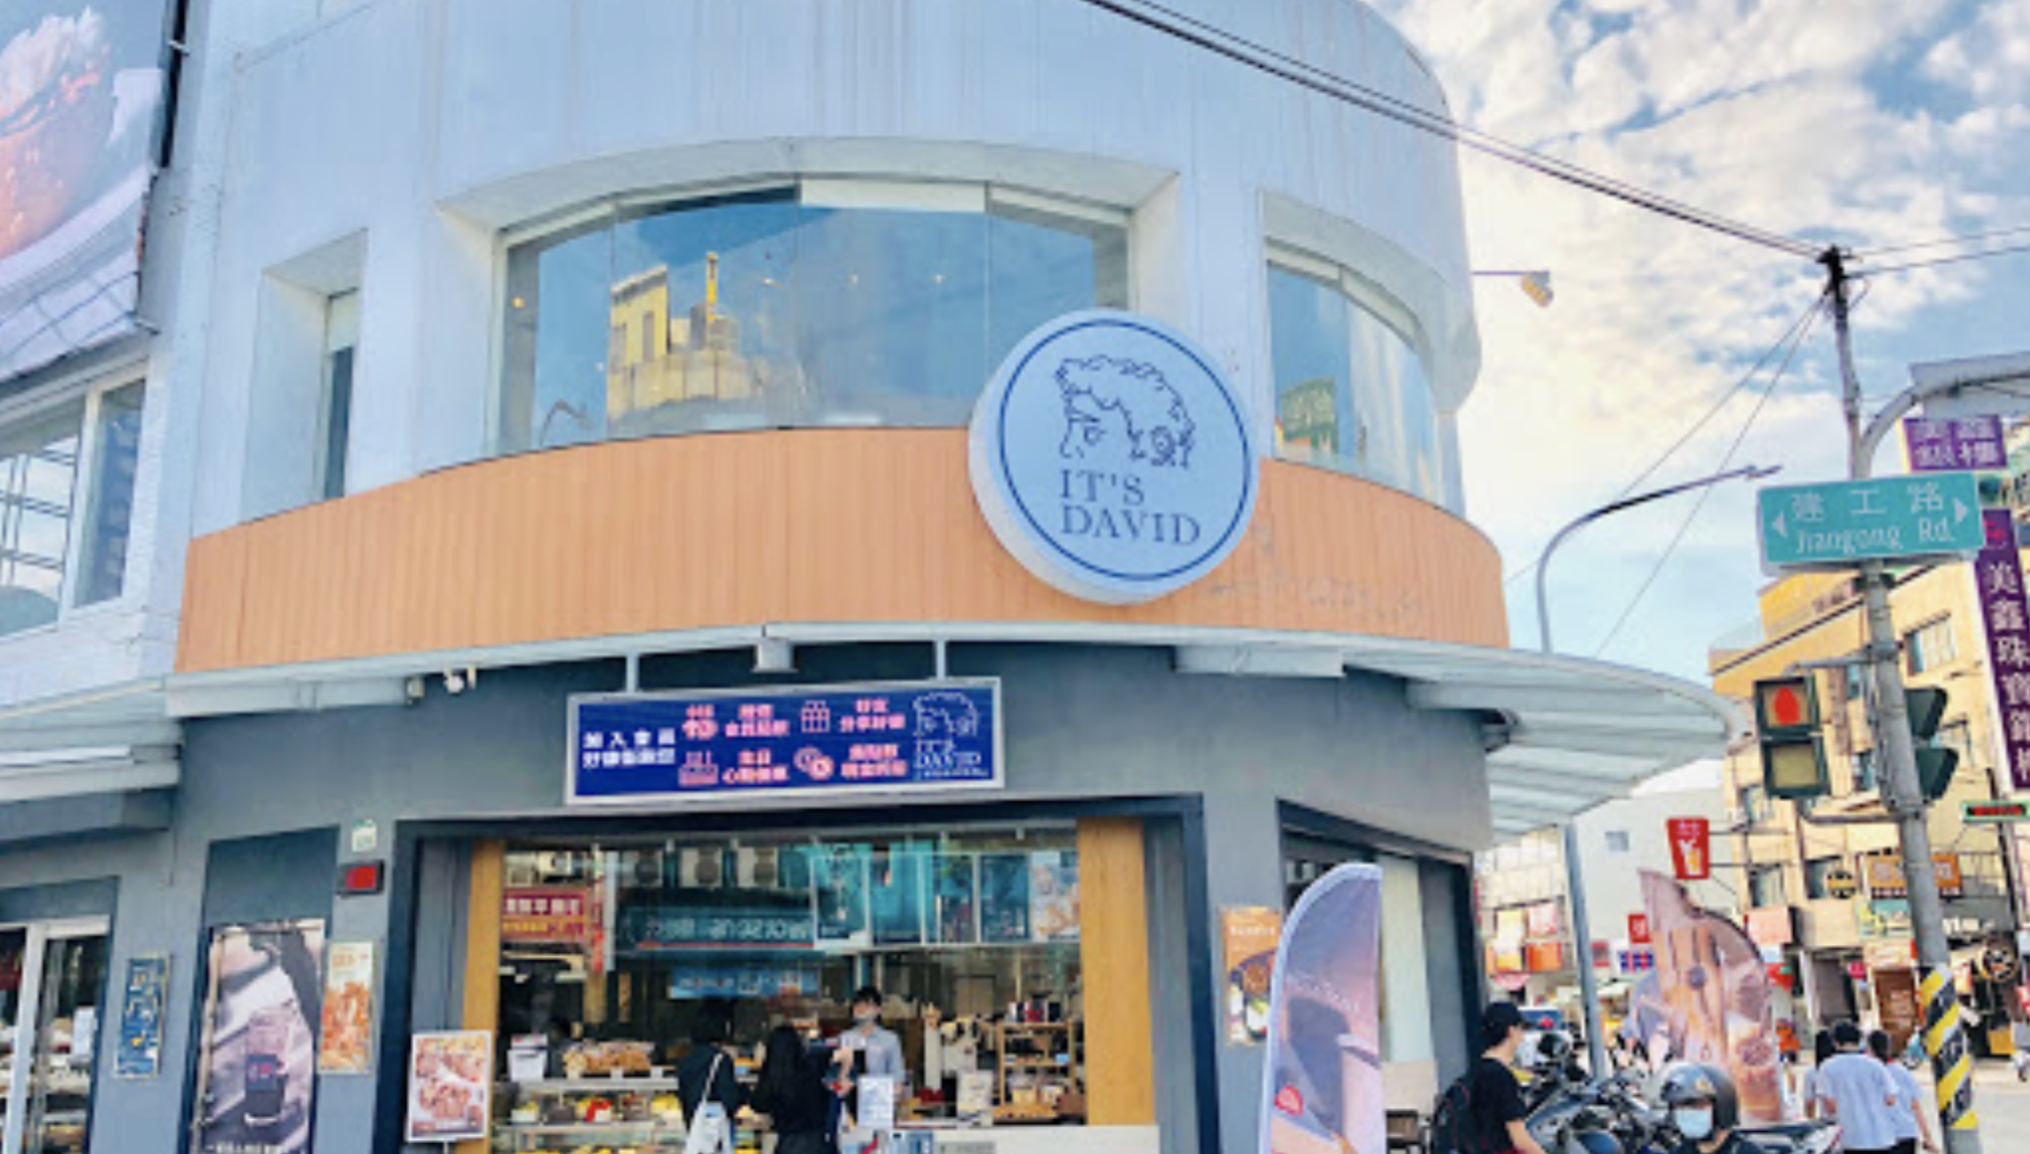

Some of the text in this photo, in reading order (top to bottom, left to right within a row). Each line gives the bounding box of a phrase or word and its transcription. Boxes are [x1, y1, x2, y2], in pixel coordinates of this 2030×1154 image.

[1060, 468, 1145, 506] IT'S
[1791, 481, 1943, 523] 建工路
[1061, 503, 1201, 546] DAVID
[1795, 526, 1903, 555] Jiangong
